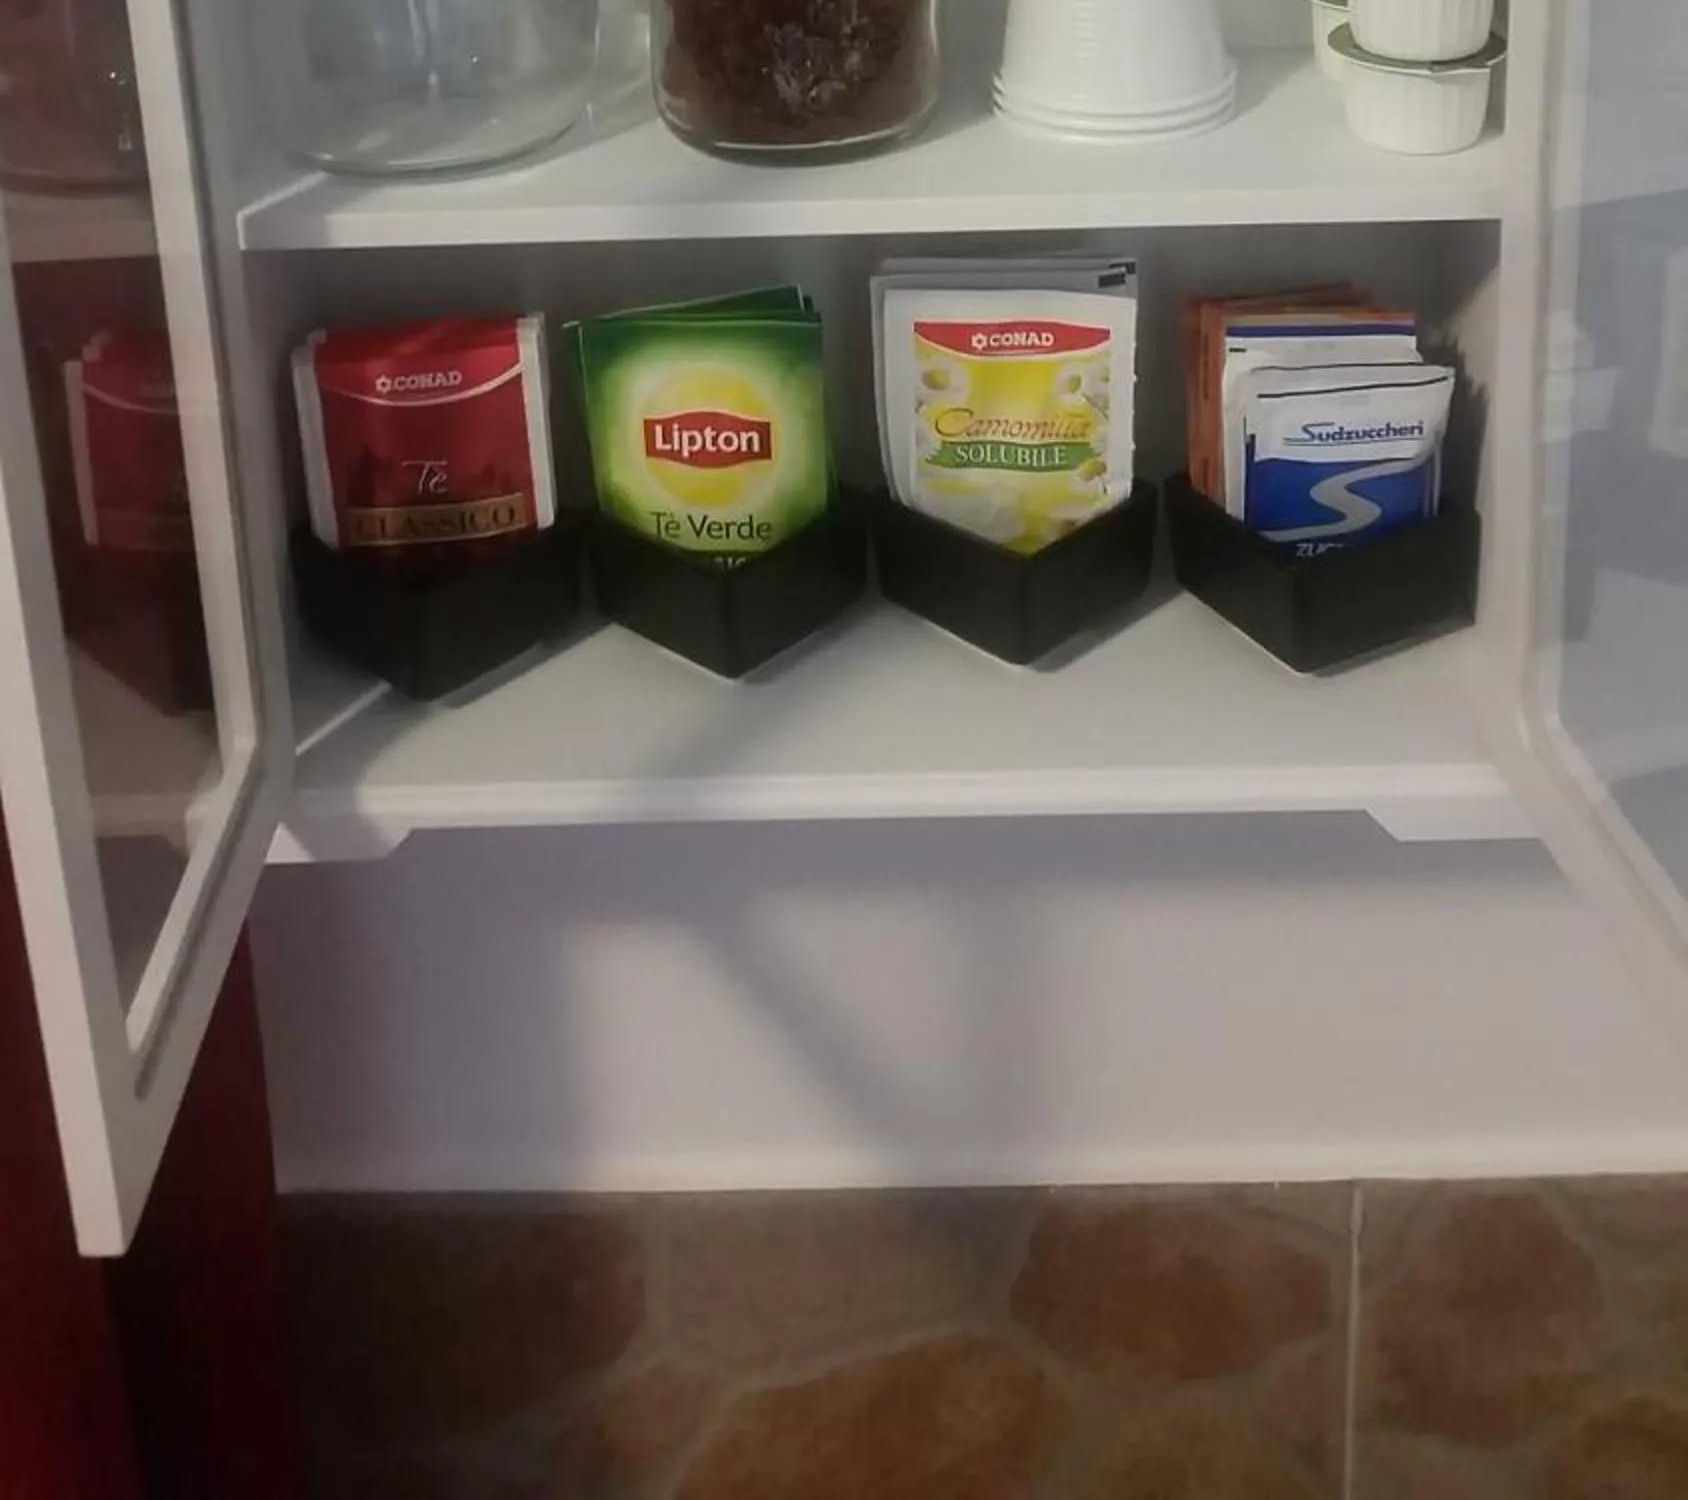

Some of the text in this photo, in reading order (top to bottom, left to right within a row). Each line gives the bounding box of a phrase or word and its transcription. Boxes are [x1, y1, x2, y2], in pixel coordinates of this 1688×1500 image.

[990, 331, 1055, 348] CONAD
[394, 370, 463, 391] CONAD
[935, 407, 1093, 439] Camomilla
[1285, 420, 1425, 444] Sudzuccheri
[654, 422, 760, 459] Lipton
[957, 444, 1068, 467] SOLUBILE
[354, 504, 518, 539] CLASSICO
[687, 513, 772, 540] Verde
